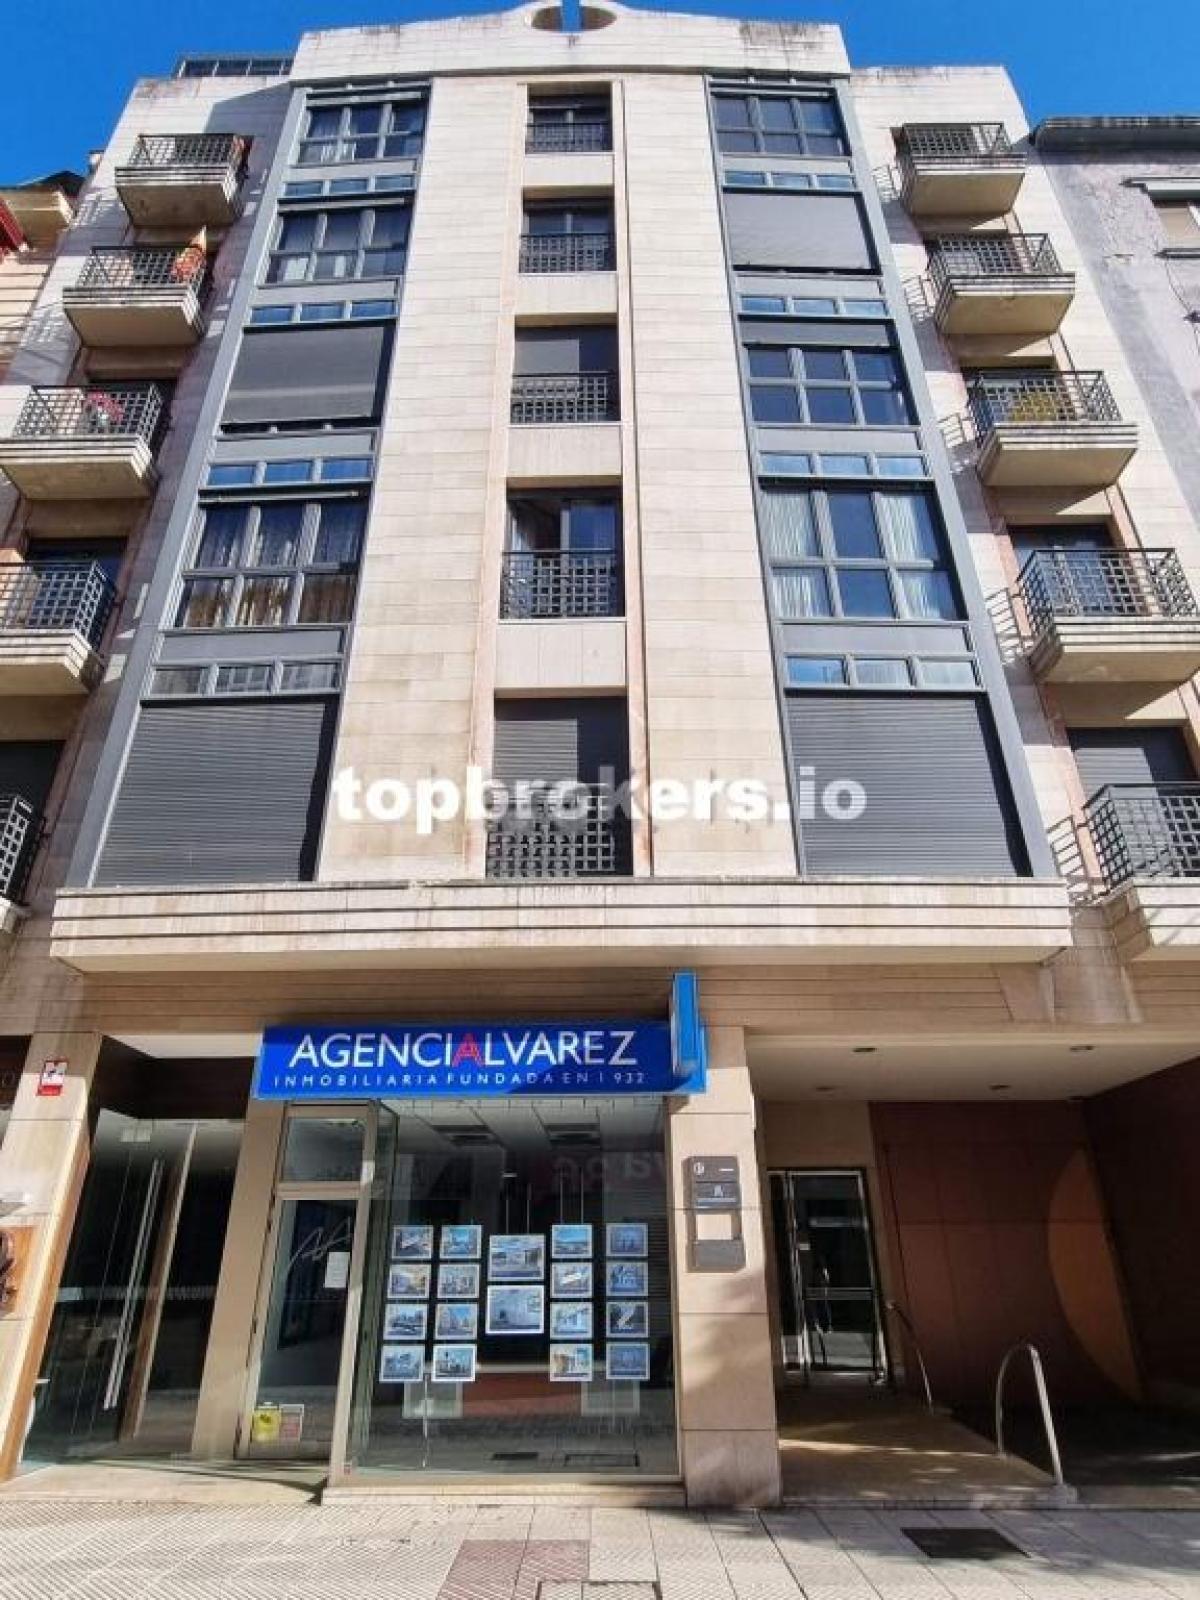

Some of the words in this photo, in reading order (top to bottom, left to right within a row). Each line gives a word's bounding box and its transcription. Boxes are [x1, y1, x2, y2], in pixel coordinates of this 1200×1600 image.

[288, 1030, 638, 1069] AGENCIALVAREZ
[273, 1073, 437, 1089] INMOBILIARIA
[446, 1072, 554, 1086] FUNDADA
[562, 1071, 589, 1085] EN
